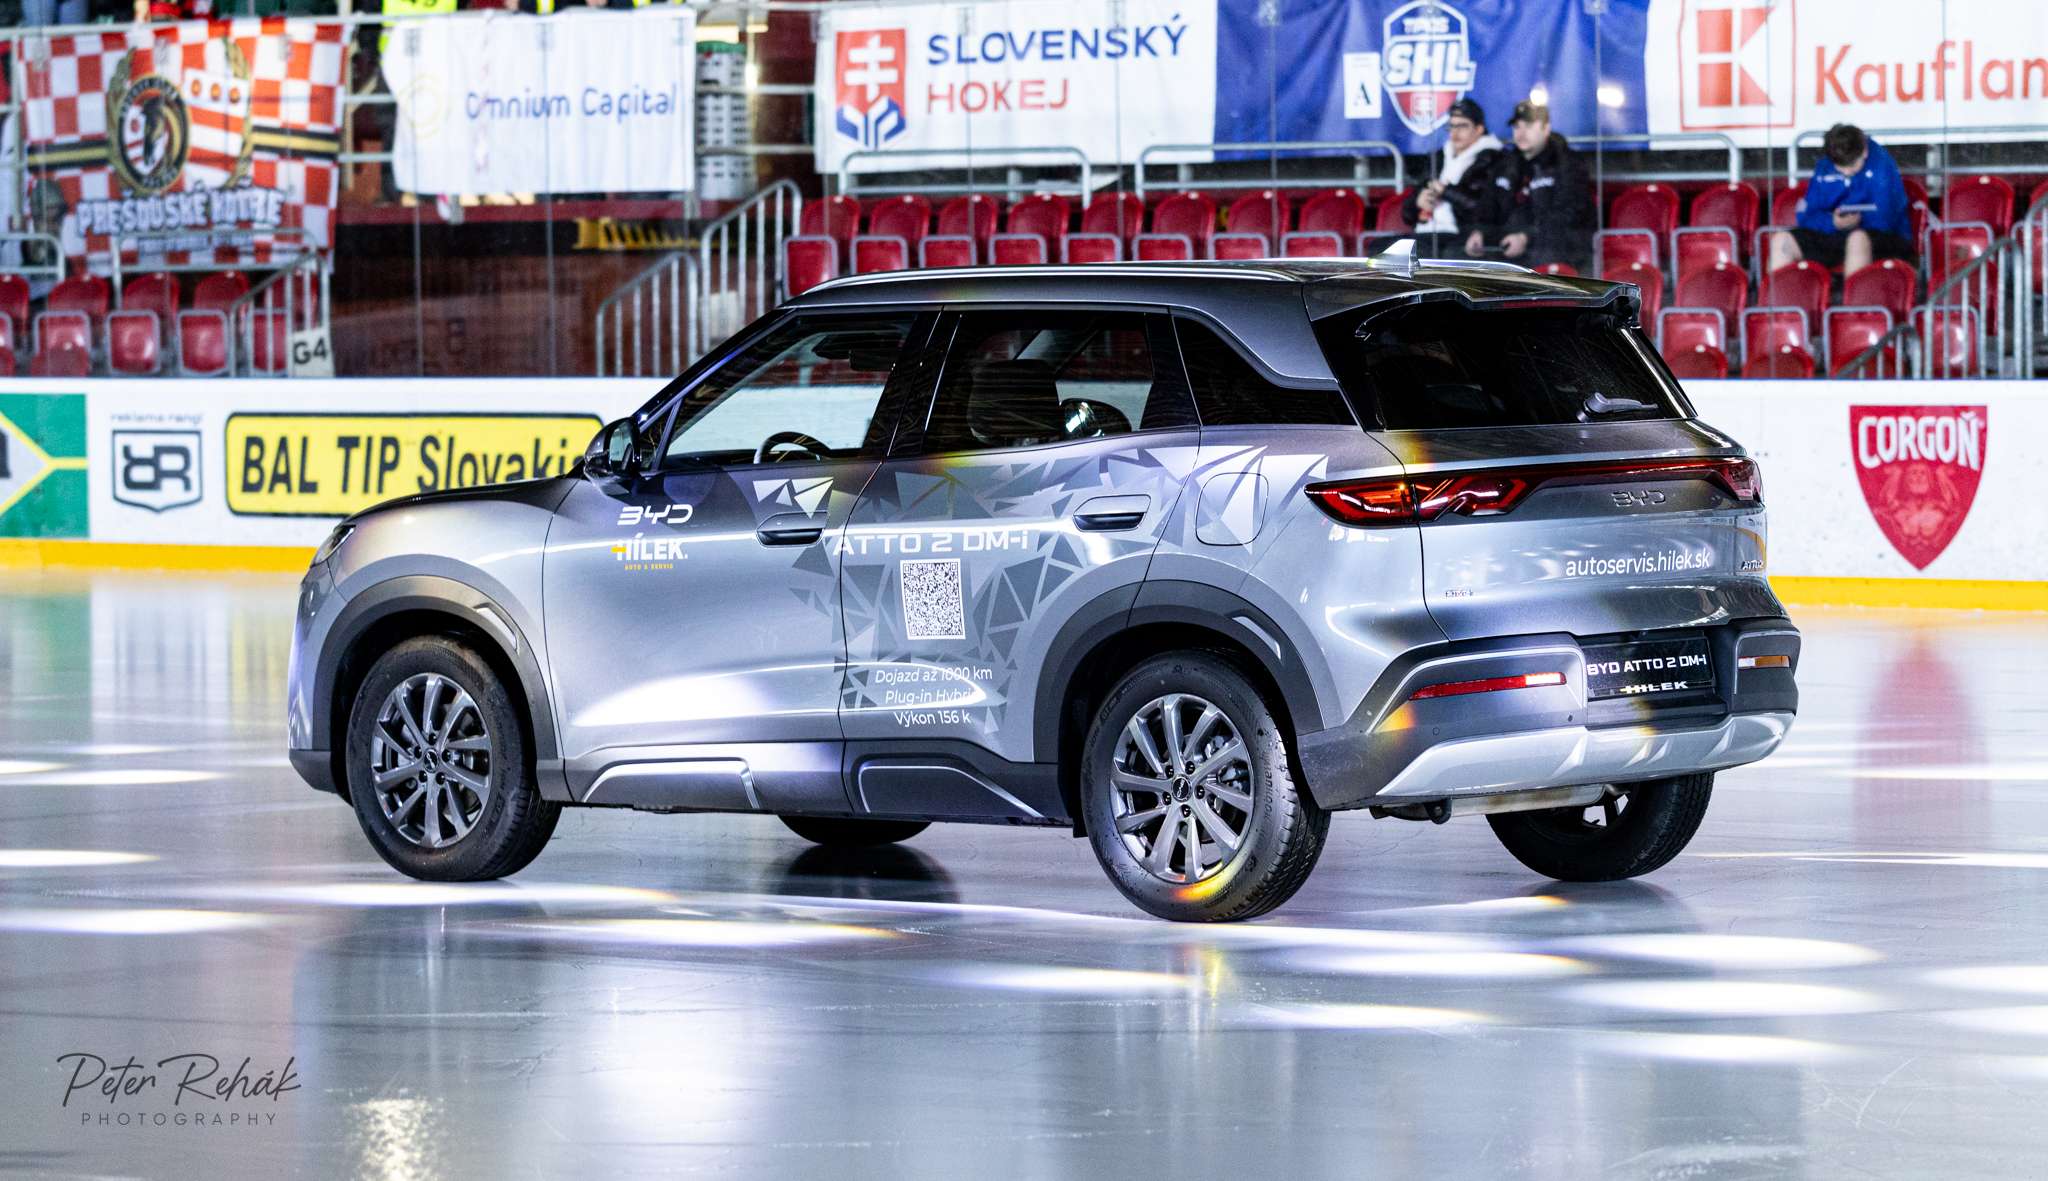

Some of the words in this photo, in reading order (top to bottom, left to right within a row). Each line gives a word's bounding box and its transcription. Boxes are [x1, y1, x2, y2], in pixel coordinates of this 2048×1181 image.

[928, 13, 1187, 66] SLOVENSKÝ
[1386, 42, 1471, 85] SHL
[465, 89, 571, 120] Omnium
[582, 83, 678, 124] Capital
[927, 78, 1069, 114] HOKEJ
[293, 337, 327, 365] G4
[1858, 411, 1980, 471] CORGOŇ
[241, 435, 319, 494] BAL
[337, 435, 401, 494] TIP
[1611, 489, 1667, 507] BYD
[617, 503, 694, 526] BYD
[833, 534, 921, 556] ATTO
[931, 532, 952, 552] 2
[963, 530, 1028, 552] DM-i
[1565, 547, 1711, 577] autoservis.hilek.sk
[875, 668, 920, 686] Dojazd
[922, 667, 938, 682] až
[941, 666, 970, 682] 1000
[973, 665, 993, 680] km
[1587, 661, 1620, 676] BYD
[1623, 658, 1664, 673] ATTO
[1666, 656, 1677, 668] 2
[1678, 654, 1707, 667] DM-i
[885, 689, 932, 706] Plug-in
[936, 687, 980, 705] Hybri
[893, 710, 936, 728] Výkon
[938, 709, 960, 724] 156
